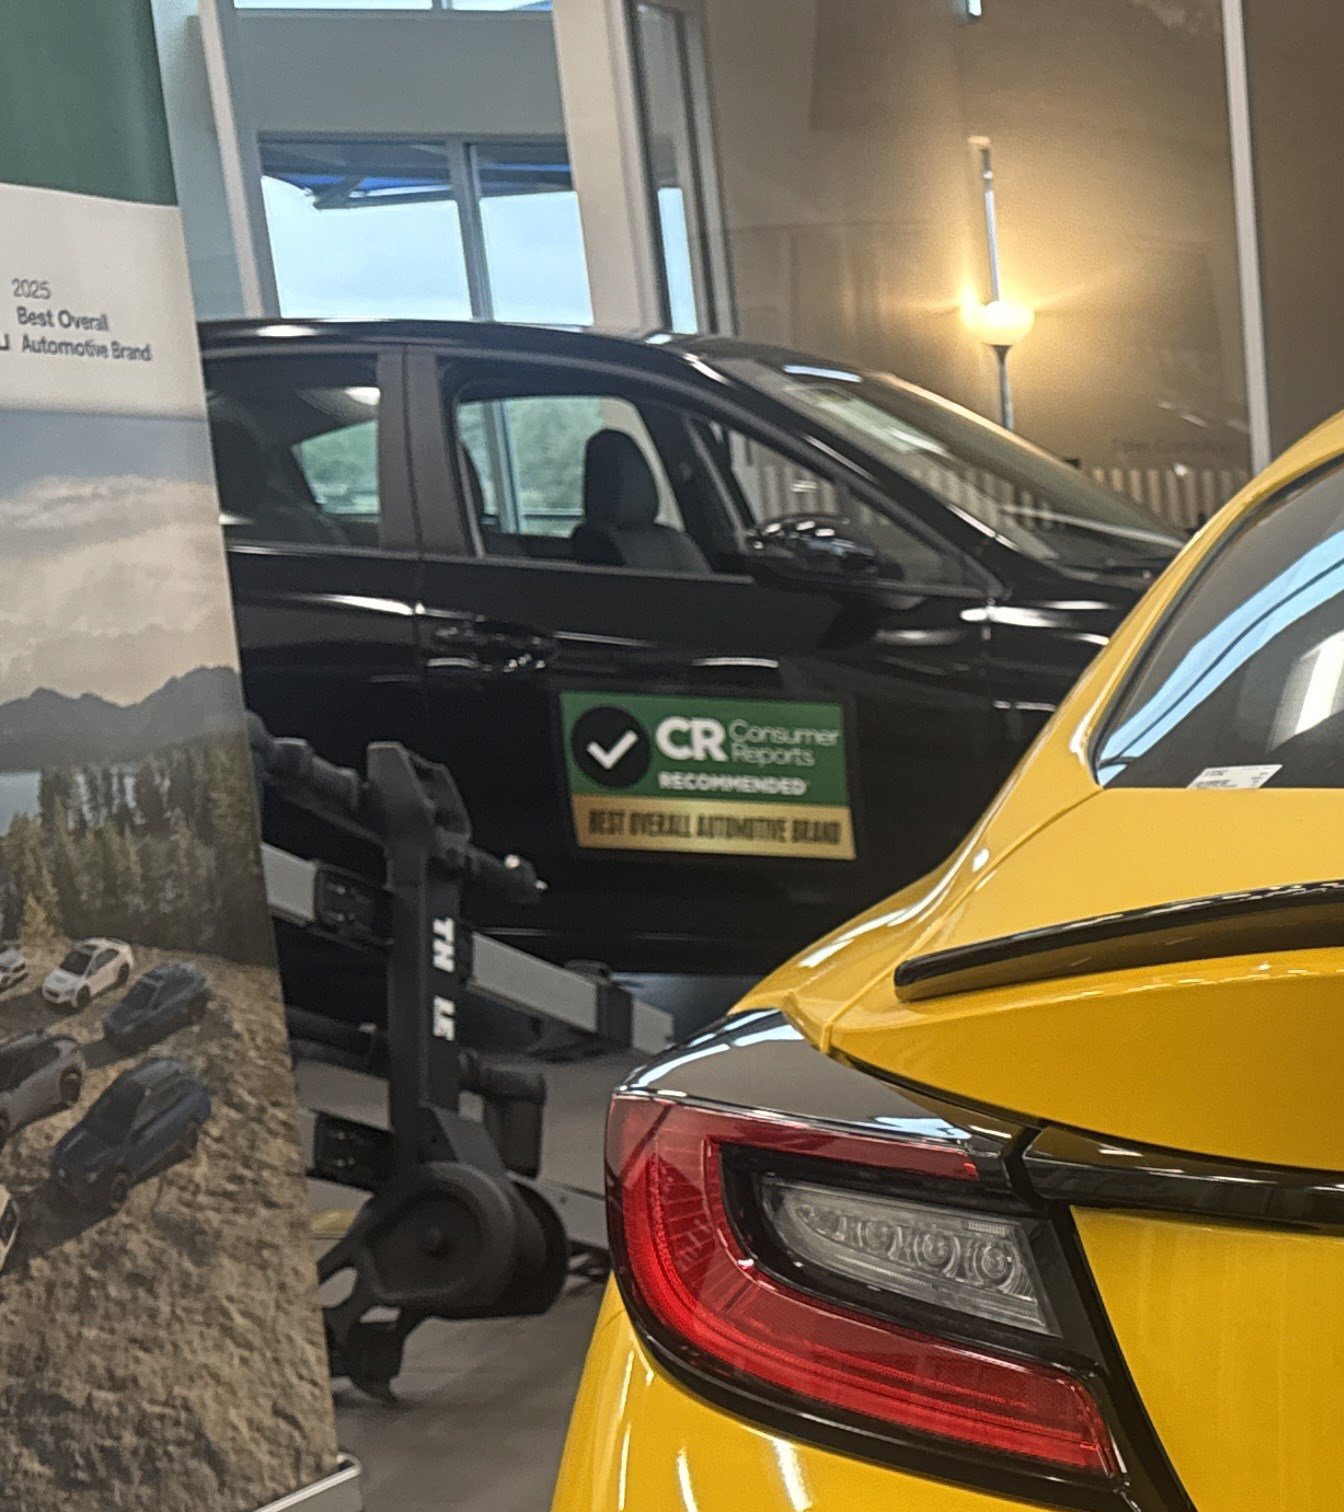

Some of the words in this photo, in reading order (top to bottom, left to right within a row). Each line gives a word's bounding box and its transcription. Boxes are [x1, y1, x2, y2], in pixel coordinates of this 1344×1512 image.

[12, 278, 51, 299] 2025
[17, 305, 55, 328] Best
[58, 309, 109, 332] Overall
[22, 333, 109, 358] Automotive
[111, 340, 152, 361] Brand
[656, 716, 729, 762] CR
[729, 719, 840, 748] Consumer
[731, 744, 815, 768] Reports
[658, 771, 807, 796] RECOMMENDED
